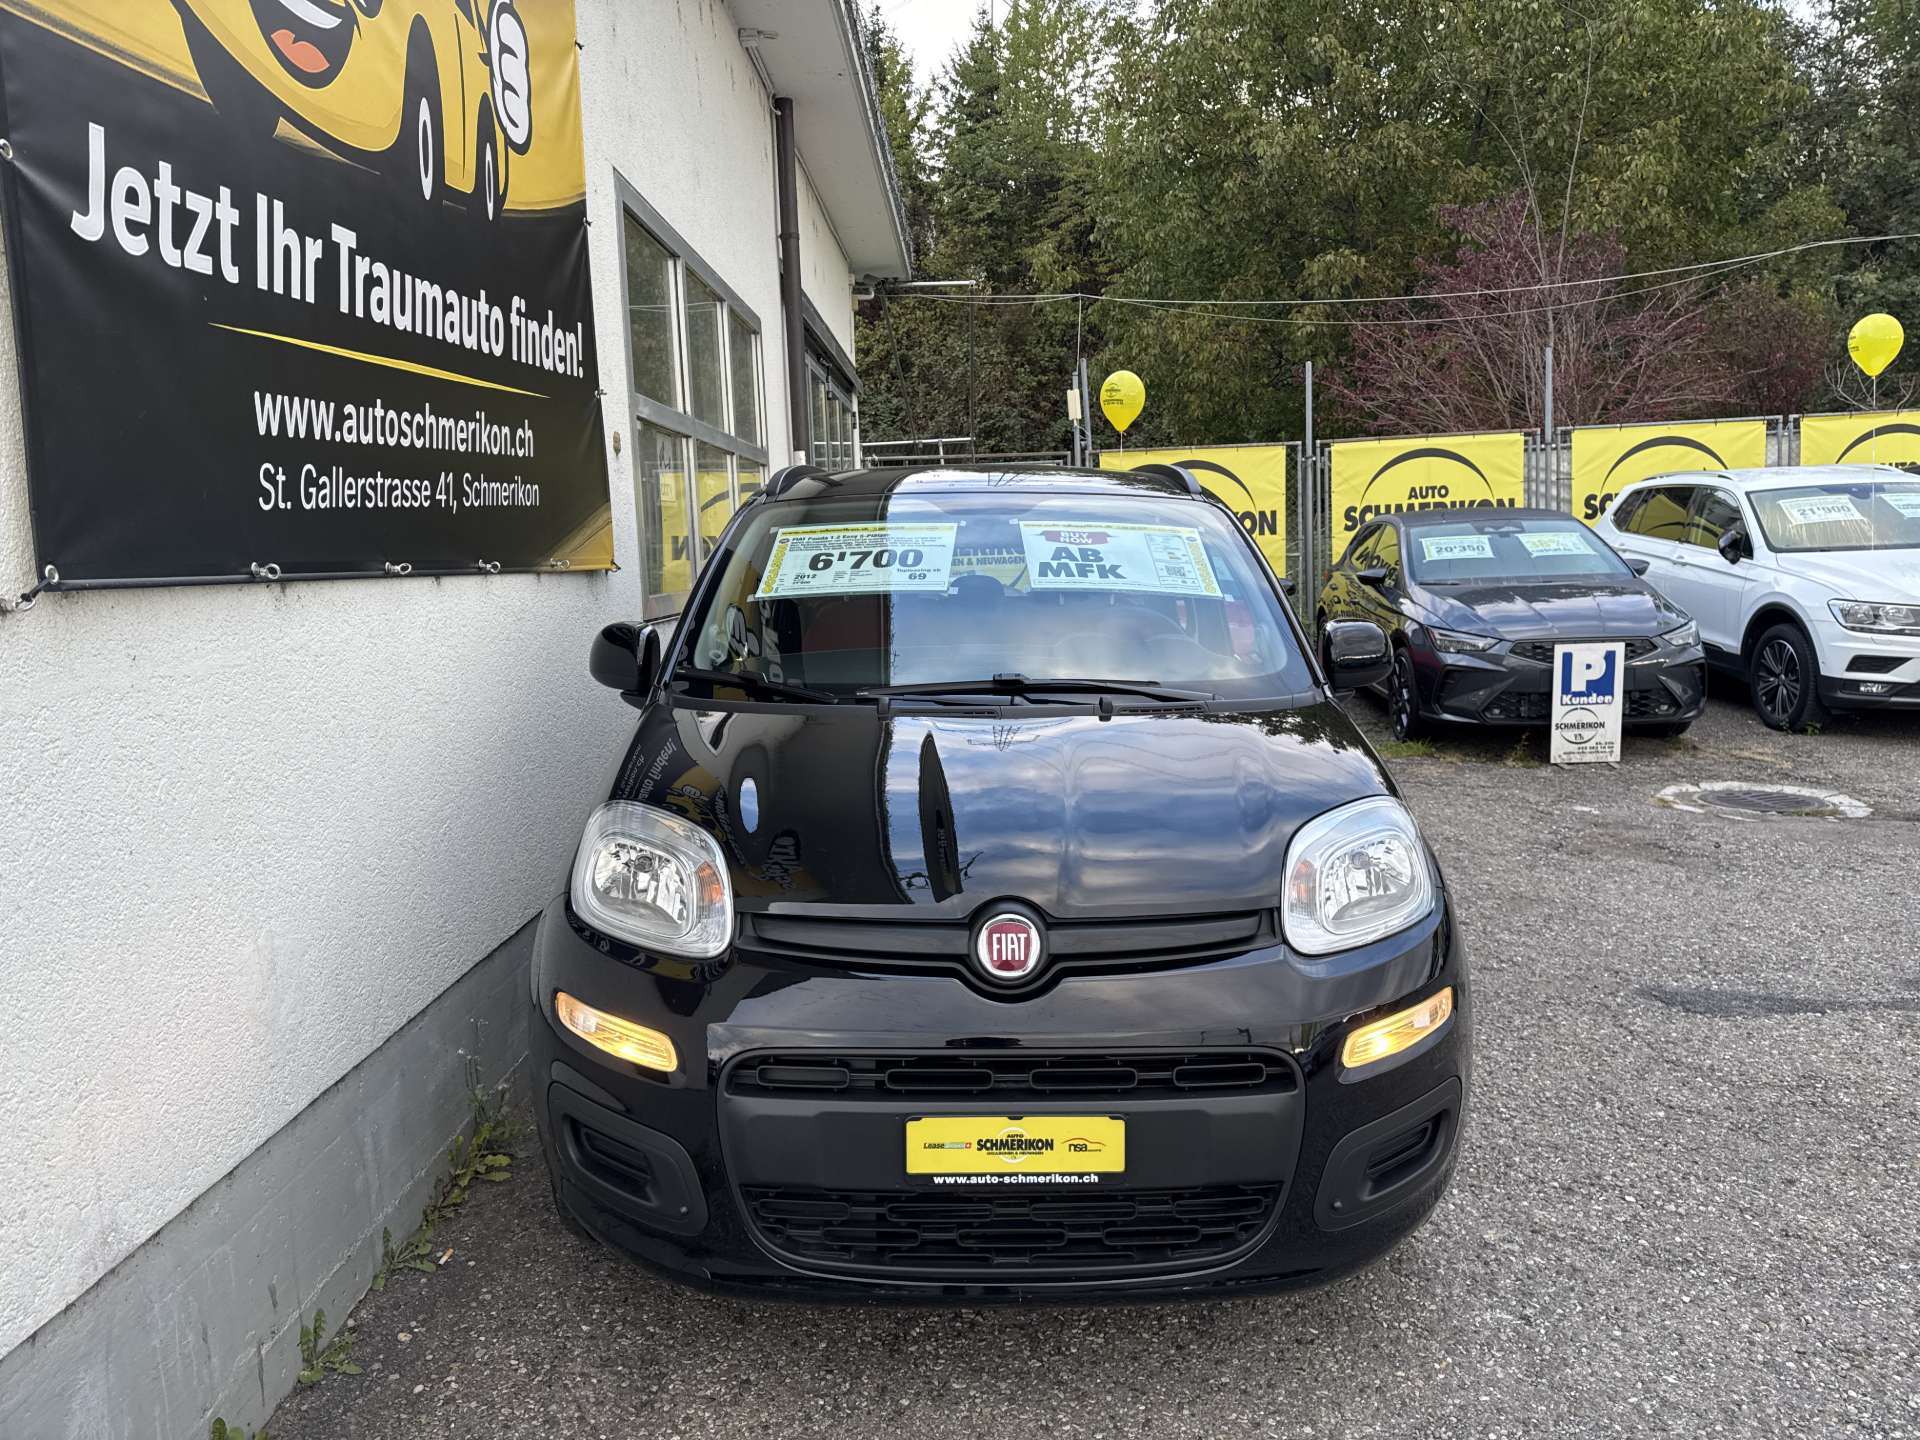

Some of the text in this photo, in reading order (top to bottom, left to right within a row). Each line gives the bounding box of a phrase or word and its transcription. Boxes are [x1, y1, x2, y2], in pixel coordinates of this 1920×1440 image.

[71, 121, 584, 378] Jetzt Ihr Traumauto finden!
[254, 391, 535, 458] www.autoschmerikon.ch
[258, 463, 540, 515] St. Gallerstrasse 41, Schmerikon
[1408, 485, 1449, 500] AUTO
[1060, 536, 1093, 544] NOW
[808, 548, 924, 572] 6'700
[1050, 546, 1105, 563] AB
[908, 572, 927, 580] 69
[1038, 561, 1127, 579] MFK
[1571, 650, 1607, 692] P
[1562, 694, 1613, 705] Kunden
[1554, 721, 1606, 731] SCHMERIKON
[992, 933, 1028, 961] FIAT
[976, 1138, 1054, 1152] SCHMERIKON
[1068, 1142, 1087, 1152] nsa
[933, 1173, 1099, 1185] www.auto-schmerikon.ch
